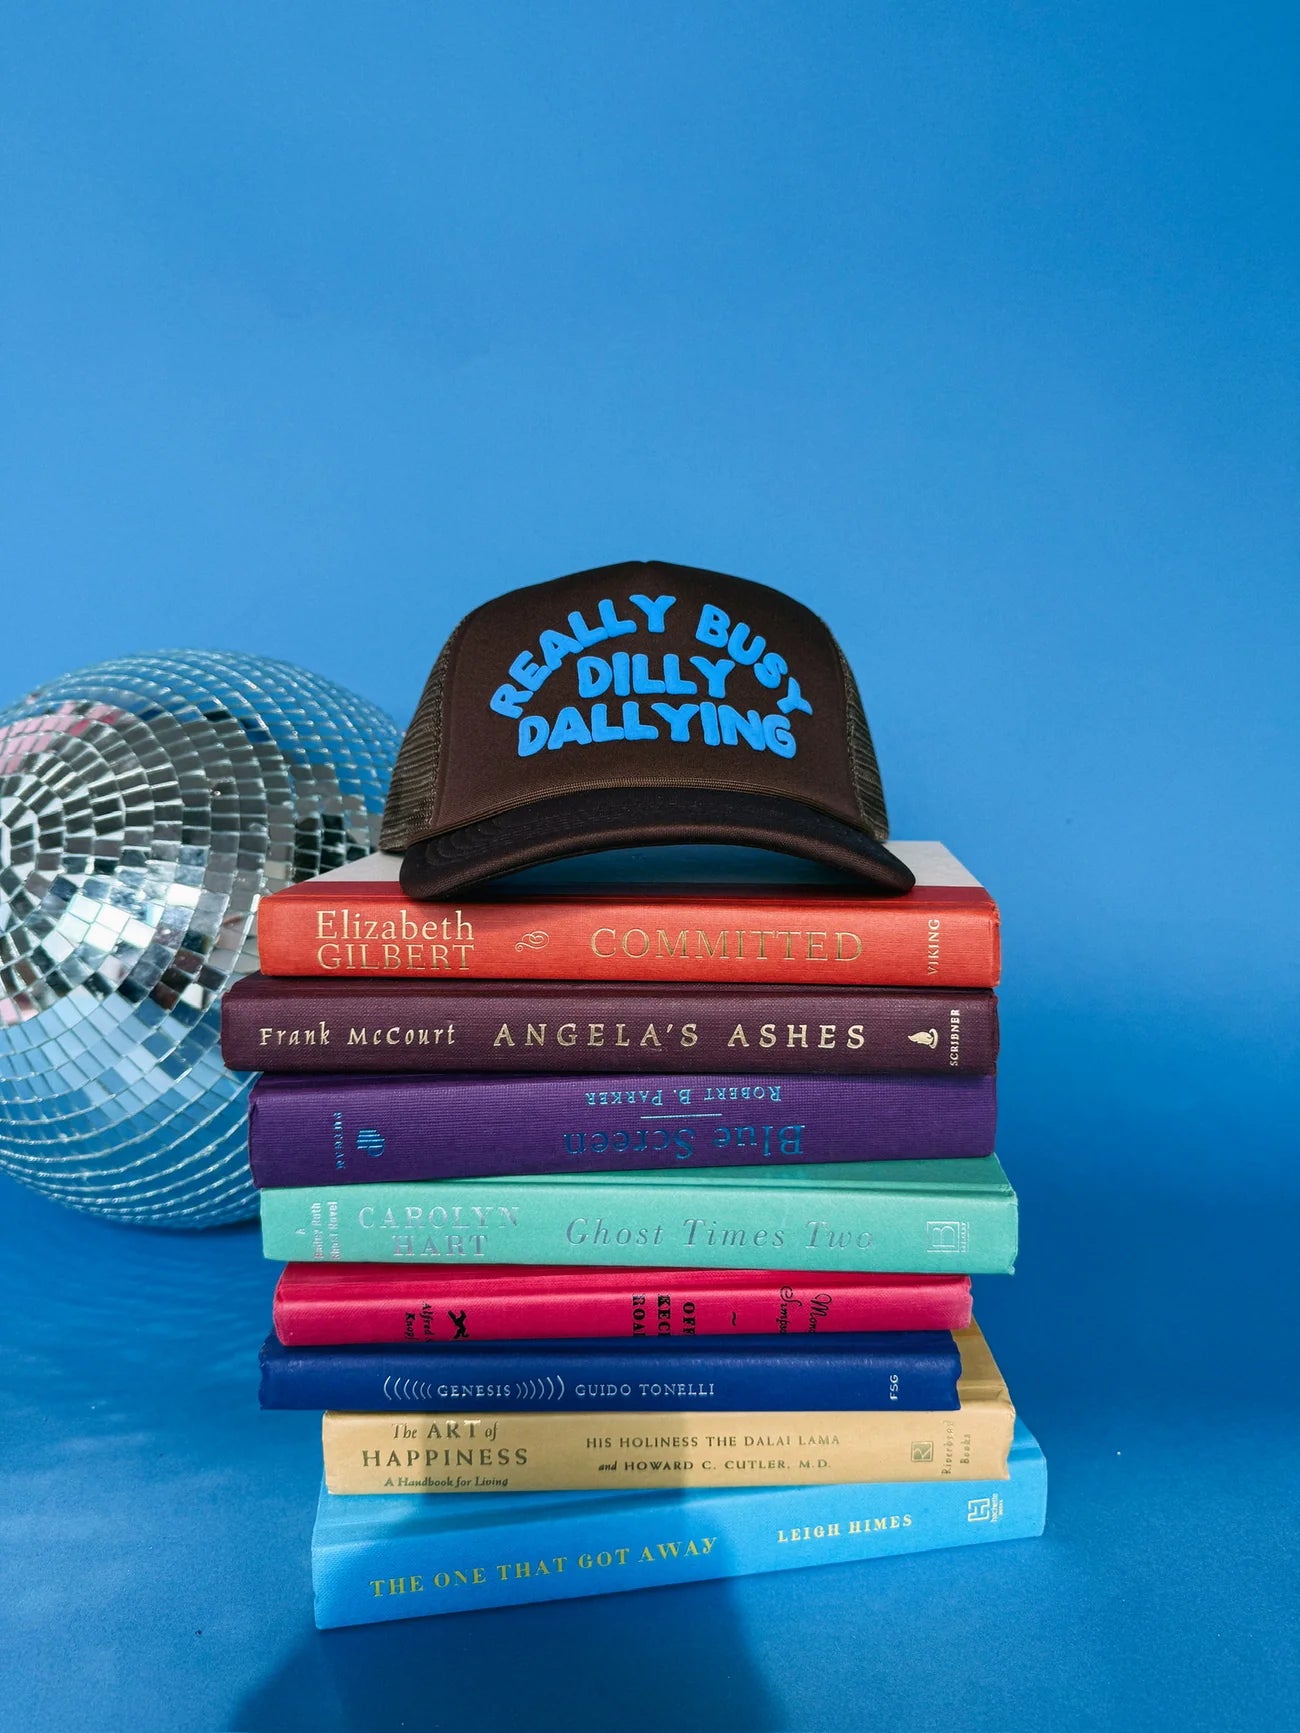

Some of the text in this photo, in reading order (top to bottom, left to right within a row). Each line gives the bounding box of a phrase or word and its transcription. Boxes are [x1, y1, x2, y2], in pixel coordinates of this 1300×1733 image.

[490, 594, 813, 719] REALLY BUSY
[576, 652, 736, 699] DILLY
[517, 701, 797, 759] DALLYING
[315, 909, 475, 941] Elizabeth
[317, 943, 475, 971] GILBERT
[590, 928, 864, 962] COMMITTED
[926, 918, 941, 977] VIKING
[259, 1021, 456, 1046] Frank McCourt
[493, 1022, 866, 1050] ANGELA'S ASHES
[949, 1008, 961, 1067] SCRIBNER
[585, 1086, 782, 1106] ROBERT B. PARKER
[563, 1124, 806, 1160] Blue Screen
[358, 1206, 520, 1230] CAROLYN
[392, 1235, 489, 1257] HART
[565, 1218, 874, 1251] Ghost Times Two
[437, 1385, 512, 1397] GENESIS
[575, 1383, 715, 1396] GUIDO TONELLI
[889, 1374, 899, 1400] FSG
[392, 1420, 499, 1441] The ART of
[586, 1434, 840, 1448] HIS HOLINESS THE DALAI LAMA
[362, 1448, 528, 1467] HAPPINESS
[598, 1459, 831, 1471] and HOWARD C. CUTLER, M.D.
[384, 1474, 508, 1488] A Handbook for Living
[777, 1514, 913, 1543] LEIGH HIMES
[369, 1536, 717, 1598] THE ONE THAT GOT AWAY
